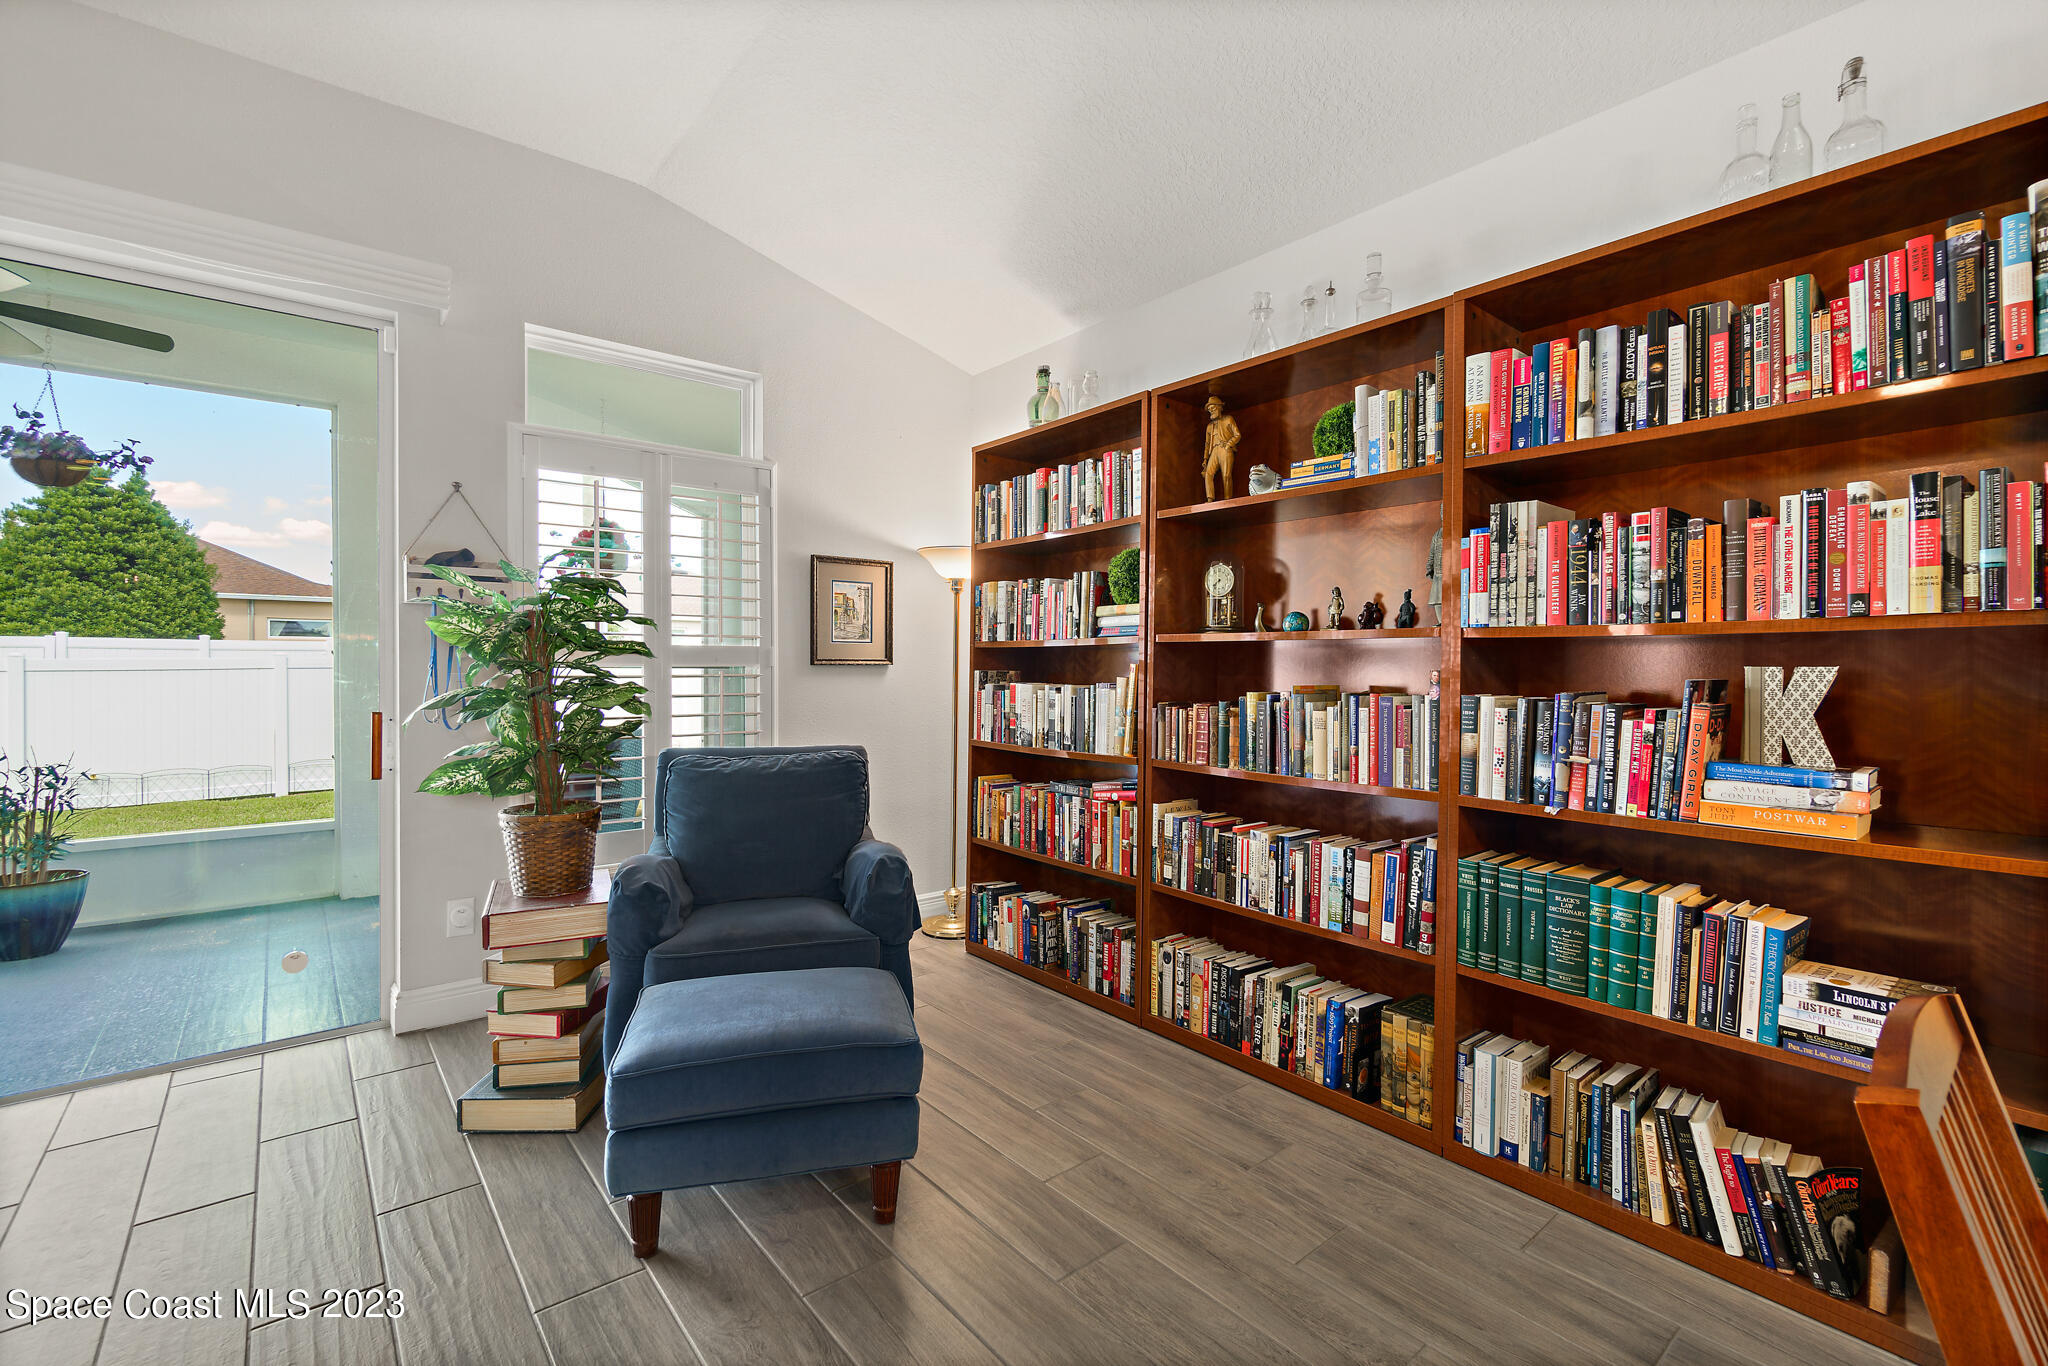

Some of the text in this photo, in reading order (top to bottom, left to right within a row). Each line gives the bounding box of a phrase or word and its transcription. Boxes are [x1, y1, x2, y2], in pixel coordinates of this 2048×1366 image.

[2007, 220, 2017, 260] IN WINTER
[2018, 231, 2028, 253] TRAIN
[1957, 260, 1967, 303] IN PARADISE
[1966, 257, 1975, 293] BAYONETS
[1989, 271, 1996, 280] OF
[1796, 281, 1804, 314] MIDNIGHT
[1894, 293, 1902, 311] THIRD
[1755, 316, 1762, 326] IN
[1796, 319, 1804, 339] BROAD
[1894, 313, 1902, 331] REICH
[1625, 341, 1636, 380] PACIFIC
[1713, 341, 1724, 364] HELL'S
[1467, 366, 1475, 403] AT DAWN
[1475, 364, 1485, 402] AN ARMY
[1551, 342, 1564, 401] FORGOTTEN ALLY
[1713, 365, 1724, 391] CARTEL
[1501, 388, 1507, 396] AT
[1515, 387, 1523, 396] IN
[1522, 386, 1530, 417] CRUSADE
[1467, 405, 1475, 439] ATKINSON
[1600, 398, 1608, 424] ATLANTIC
[1417, 424, 1426, 442] WAR
[1605, 515, 1614, 554] COUNTDOWN
[1754, 527, 1767, 544] THE
[1784, 525, 1793, 540] THE
[1828, 515, 1837, 542] DEFEAT
[1837, 506, 1846, 549] EMBRACING
[1754, 545, 1767, 568] TRIAL
[1784, 540, 1793, 562] OTHER
[1807, 505, 1819, 599] THE BITTER TASTE OF VICTORY
[1856, 507, 1866, 589] IN THE RUINS OF EMPIRE
[1551, 560, 1560, 573] THE
[1569, 549, 1588, 586] 1944
[1605, 555, 1613, 574] 1945
[1691, 559, 1702, 606] DOWNFALL
[1753, 574, 1766, 611] GERMANS
[1832, 567, 1841, 592] DOWER
[1551, 575, 1560, 615] VOLUNTEER
[1570, 588, 1578, 613] WINIK
[1578, 593, 1586, 607] JAY
[1605, 708, 1616, 726] LOST
[1536, 722, 1544, 742] MEN
[1542, 710, 1551, 755] MONUMENTS
[1605, 727, 1614, 736] IN
[1665, 718, 1676, 754] CODE TALKER
[1631, 727, 1642, 774] ORDINARY MEN
[1684, 722, 1703, 809] D-DAY GIRLS
[1720, 791, 1792, 805] CONTINENT
[1732, 784, 1777, 796] SAVAGE
[1708, 805, 1737, 815] TONY
[1708, 812, 1737, 822] JUDT
[1753, 809, 1828, 826] POSTWAR
[1407, 849, 1423, 910] The Century
[1549, 905, 1587, 918] DICTIONARY
[1684, 912, 1692, 926] THE
[1683, 927, 1691, 945] NINE
[1680, 952, 1690, 979] JEFFREY
[1704, 929, 1716, 982] INTERNATIONALISTS
[1766, 942, 1777, 973] THEORY
[1220, 967, 1228, 999] DISCIPLES
[1766, 972, 1775, 981] OF
[1679, 980, 1688, 1006] TOOBIN
[1764, 980, 1774, 1010] JUSTICE
[1832, 989, 1888, 1012] LINCOLN'S
[1798, 1000, 1842, 1019] JUSTICE
[1254, 1015, 1264, 1045] Caste
[1463, 1082, 1473, 1134] MAGNA CARTA
[1508, 1062, 1518, 1142] IN OUR OWN WORDS
[1721, 1151, 1735, 1188] The Right to
[1829, 1173, 1860, 1191] Years
[1685, 1157, 1708, 1217] JEFFREY TOOBIN
